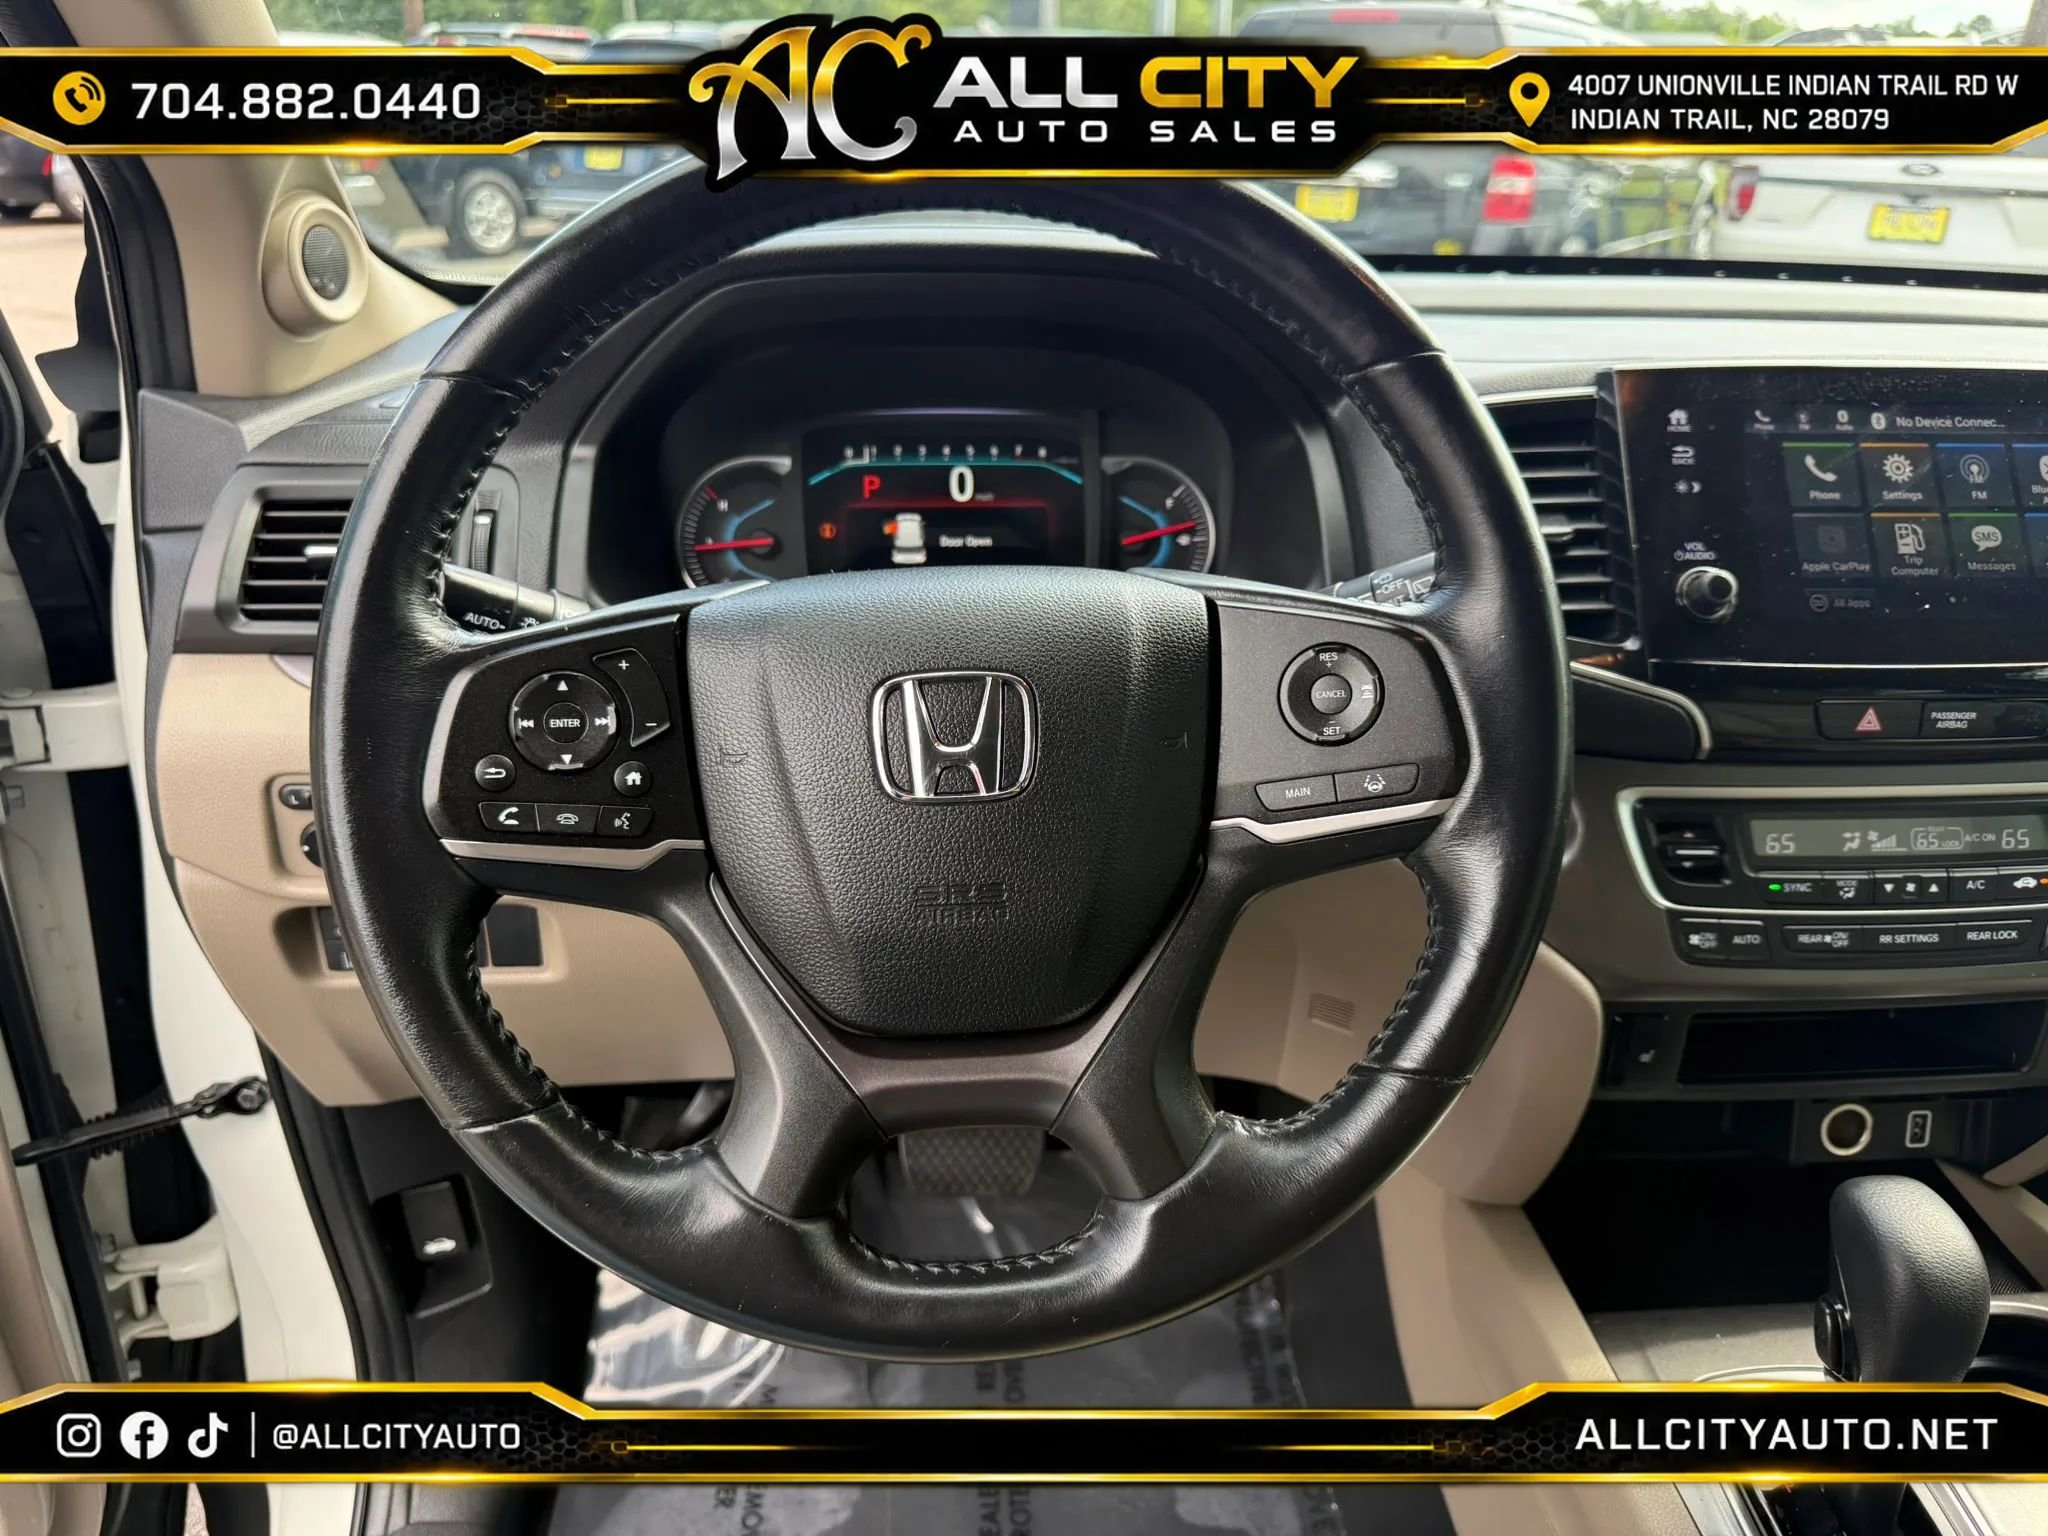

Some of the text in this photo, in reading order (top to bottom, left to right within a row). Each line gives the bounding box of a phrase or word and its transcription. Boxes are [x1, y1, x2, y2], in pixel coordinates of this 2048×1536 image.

[1896, 416, 1913, 427] No
[1915, 416, 1953, 428] Device
[863, 475, 881, 499] P
[949, 465, 975, 502] 0
[1809, 490, 1840, 500] Phone
[1882, 491, 1923, 502] Settings
[1971, 491, 1988, 500] FM
[939, 534, 993, 548] Door Open
[1974, 531, 1999, 542] SMS
[1904, 555, 1923, 565] Trip
[1801, 561, 1871, 573] Apple CarPlay
[1890, 566, 1939, 577] Computer
[1967, 561, 2017, 572] Messages
[465, 612, 500, 630] AUTO
[1319, 652, 1338, 662] RES
[1315, 689, 1347, 699] CANCEL
[1930, 711, 1977, 720] PASSENGER
[549, 718, 581, 729] ENTER
[1935, 720, 1968, 728] AIRBAG
[1322, 725, 1341, 736] SET
[1284, 786, 1311, 798] MAIN
[1916, 832, 1939, 848] 65
[1964, 832, 1996, 842] A/C ON
[2001, 828, 2030, 849] 65
[1765, 833, 1795, 854] 65
[1783, 882, 1812, 893] SYNC
[1966, 880, 1986, 890] A/C
[1732, 934, 1761, 944] AUTO
[1798, 934, 1822, 943] REAR
[1879, 933, 1940, 944] RR SETTINGS
[1966, 930, 2018, 941] REAR LOCK
